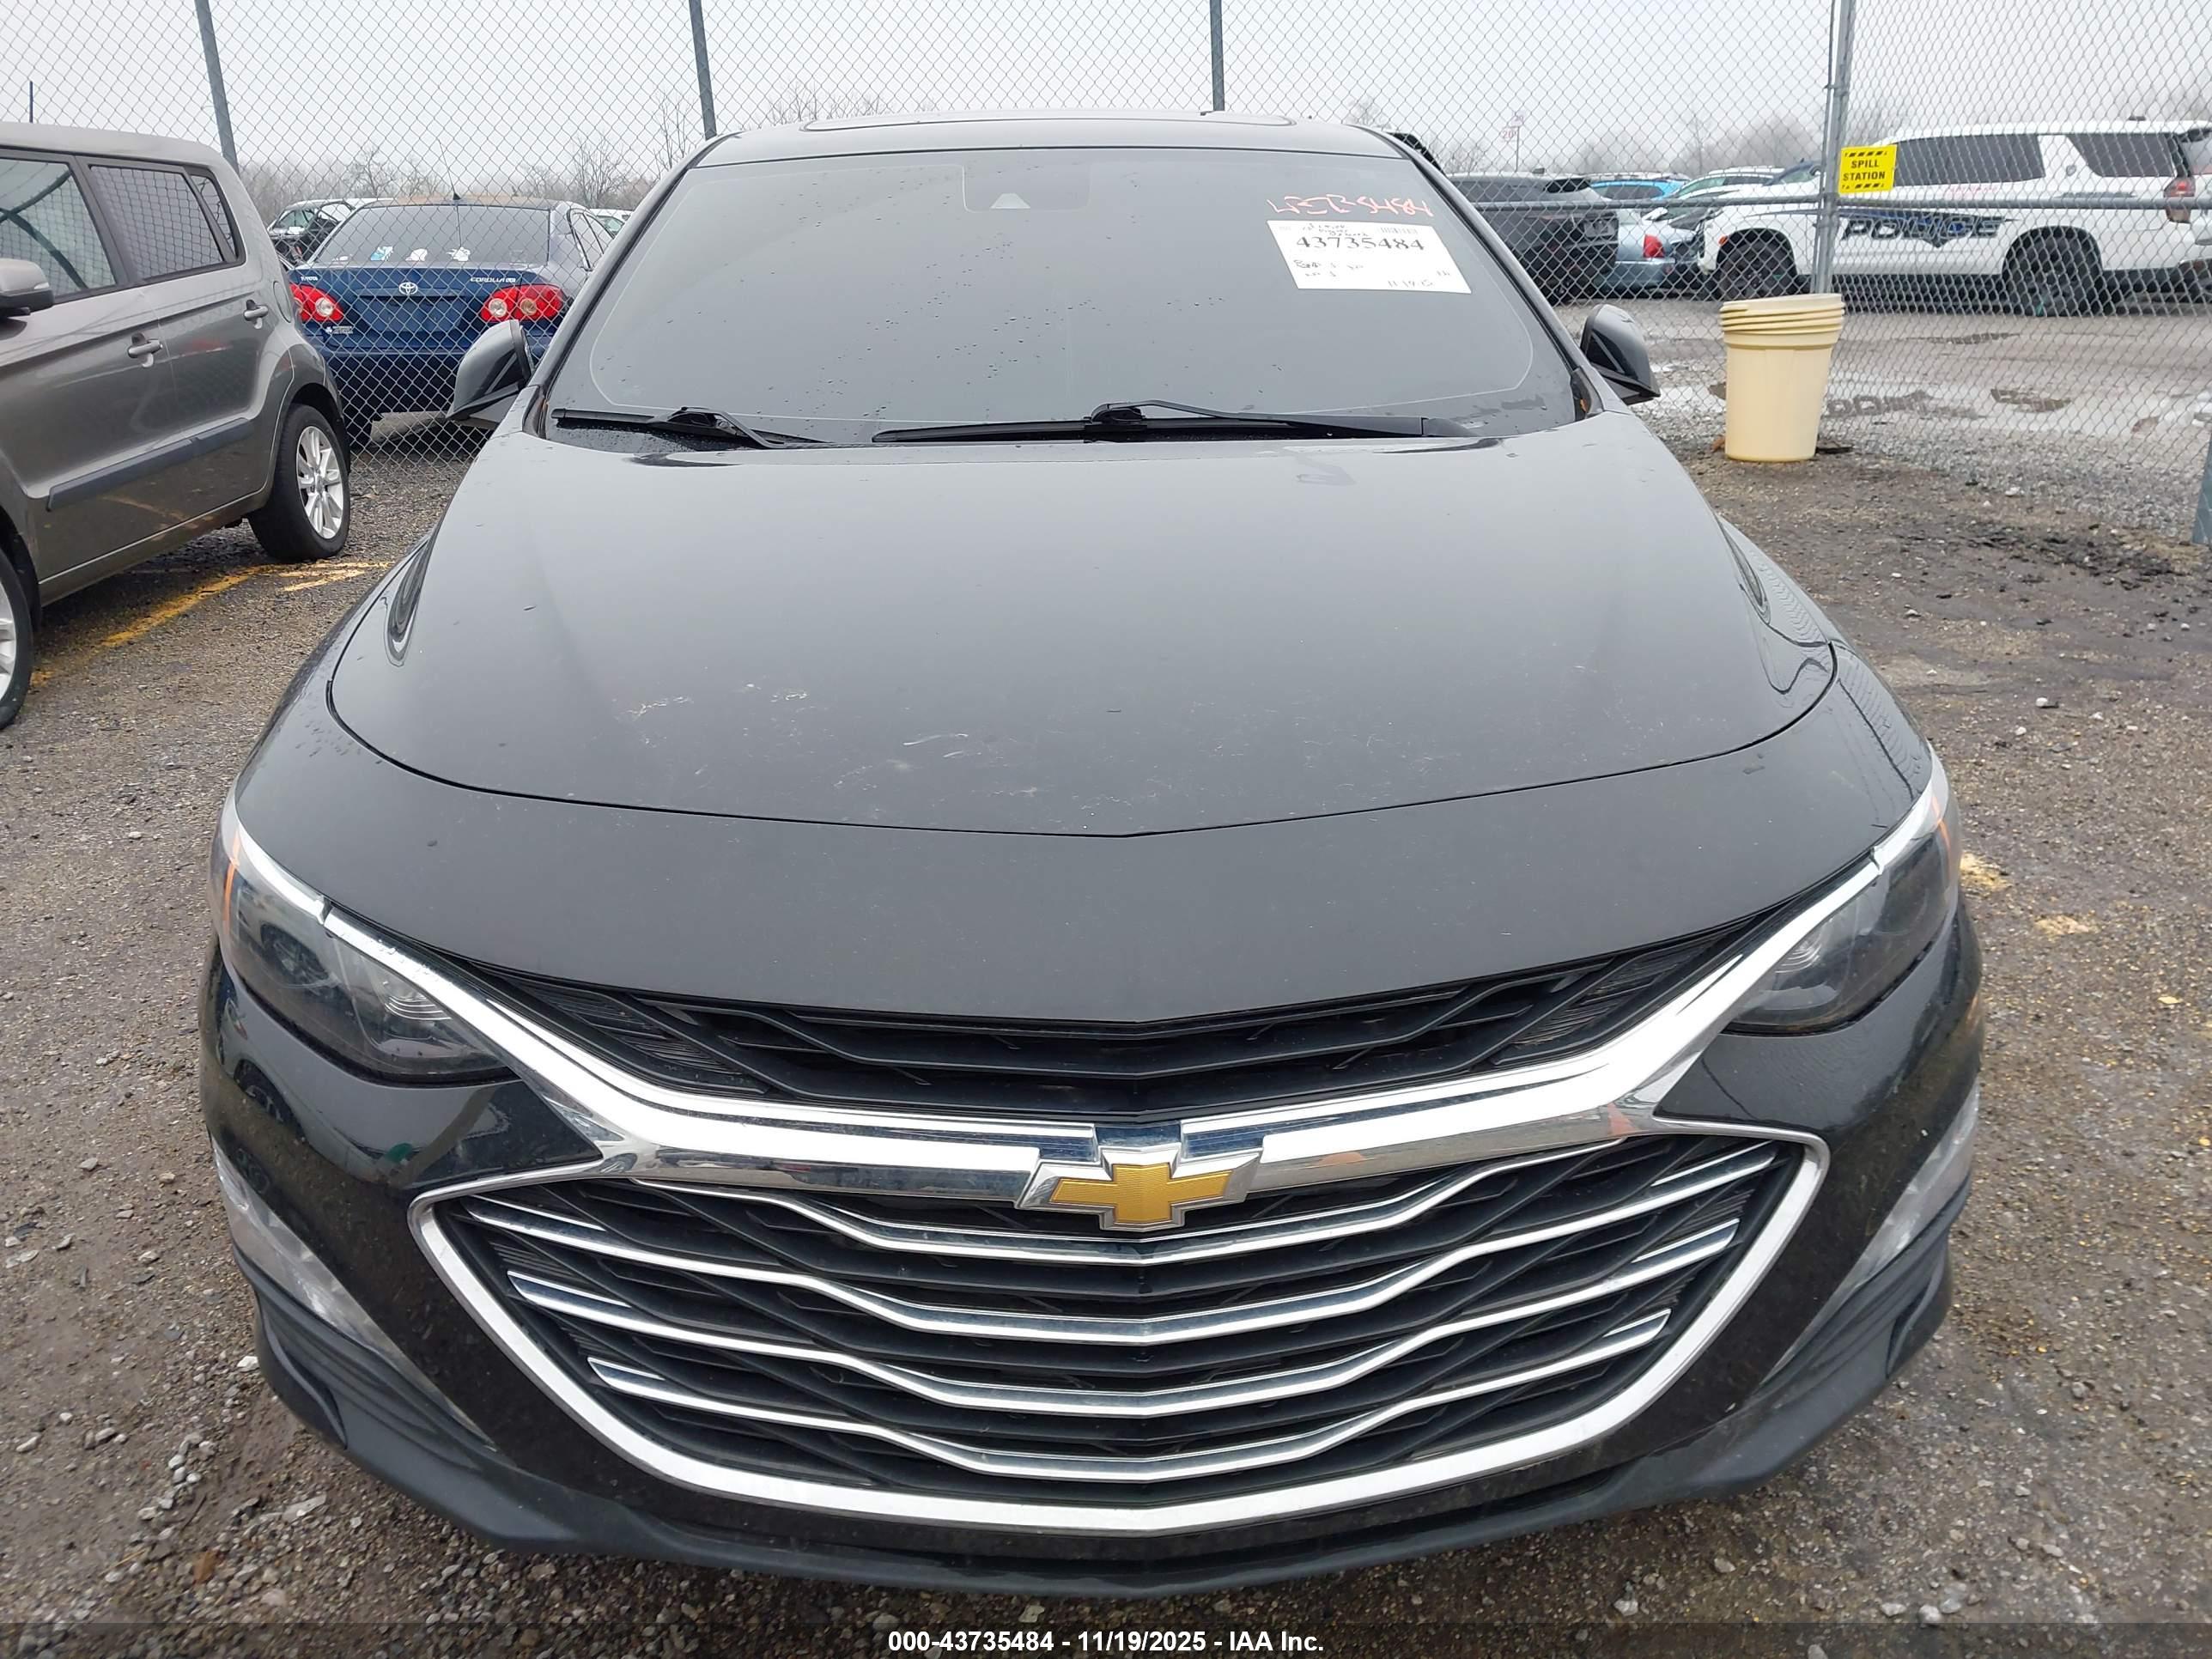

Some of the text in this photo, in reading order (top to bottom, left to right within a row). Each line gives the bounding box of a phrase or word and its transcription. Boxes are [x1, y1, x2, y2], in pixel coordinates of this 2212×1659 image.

[1850, 160, 1880, 169] SPILL
[1843, 172, 1886, 182] STATION
[1842, 216, 2006, 241] POLICE
[1297, 236, 1425, 251] 43735484
